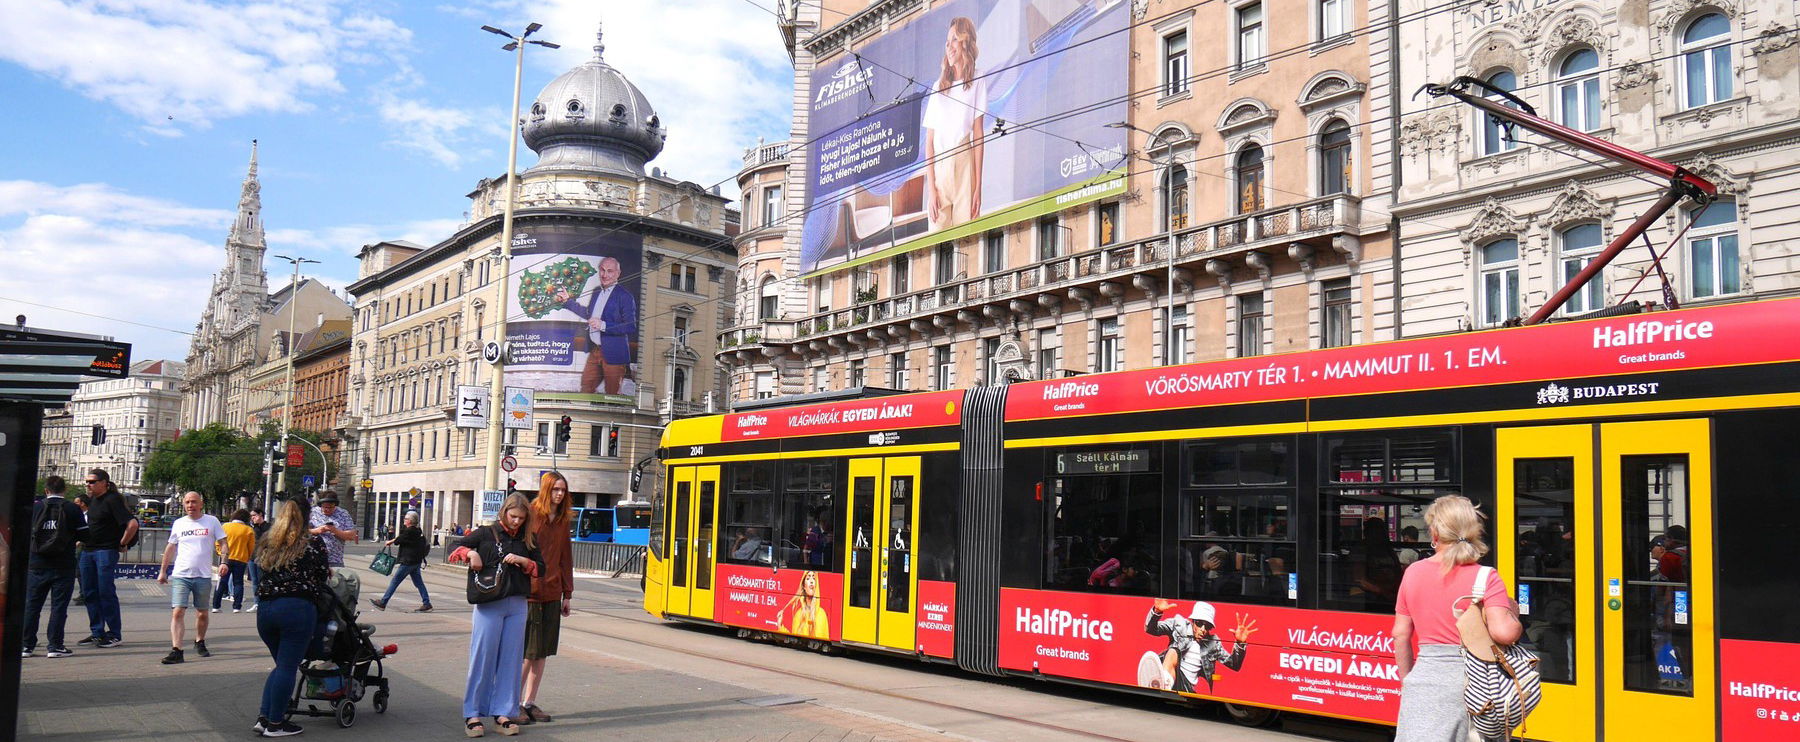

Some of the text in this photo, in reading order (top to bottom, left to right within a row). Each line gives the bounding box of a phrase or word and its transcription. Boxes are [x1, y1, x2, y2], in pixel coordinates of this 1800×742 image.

[815, 66, 874, 102] Fisher
[854, 120, 881, 138] Ramóna
[820, 133, 904, 174] Fisher klíma hozza el a jó
[821, 128, 892, 163] Nyugi Lajos! Nálunk a
[820, 155, 880, 186] időt, télen-nyáron!
[552, 341, 571, 349] hogy
[1592, 320, 1713, 349] HalfPrice
[1618, 350, 1685, 365] Great brands
[1145, 346, 1507, 396] VÖRÖSMARTY TÉR 1. MAMMUT II. 1. EM.
[1043, 382, 1099, 400] HalfPrice
[1573, 382, 1659, 399] BUDAPEST
[738, 402, 912, 427] HalfPrice VILÁGMÁRKÁK. EGYEDI ÁRAK!
[690, 446, 703, 456] 2041
[1057, 451, 1139, 473] 6 Széll Kálmán
[1094, 463, 1120, 472] tér M
[728, 574, 782, 591] VÖRÖSMARTY TÉR 1.
[730, 592, 754, 604] MAMMUT
[767, 596, 777, 606] EM.
[1016, 607, 1113, 641] HalfPrice
[1288, 626, 1396, 653] VILÁGMÁRKÁK.
[1036, 644, 1089, 661] Great brands
[1280, 652, 1342, 674] EGYEDI
[1730, 681, 1800, 701] HalfPric
